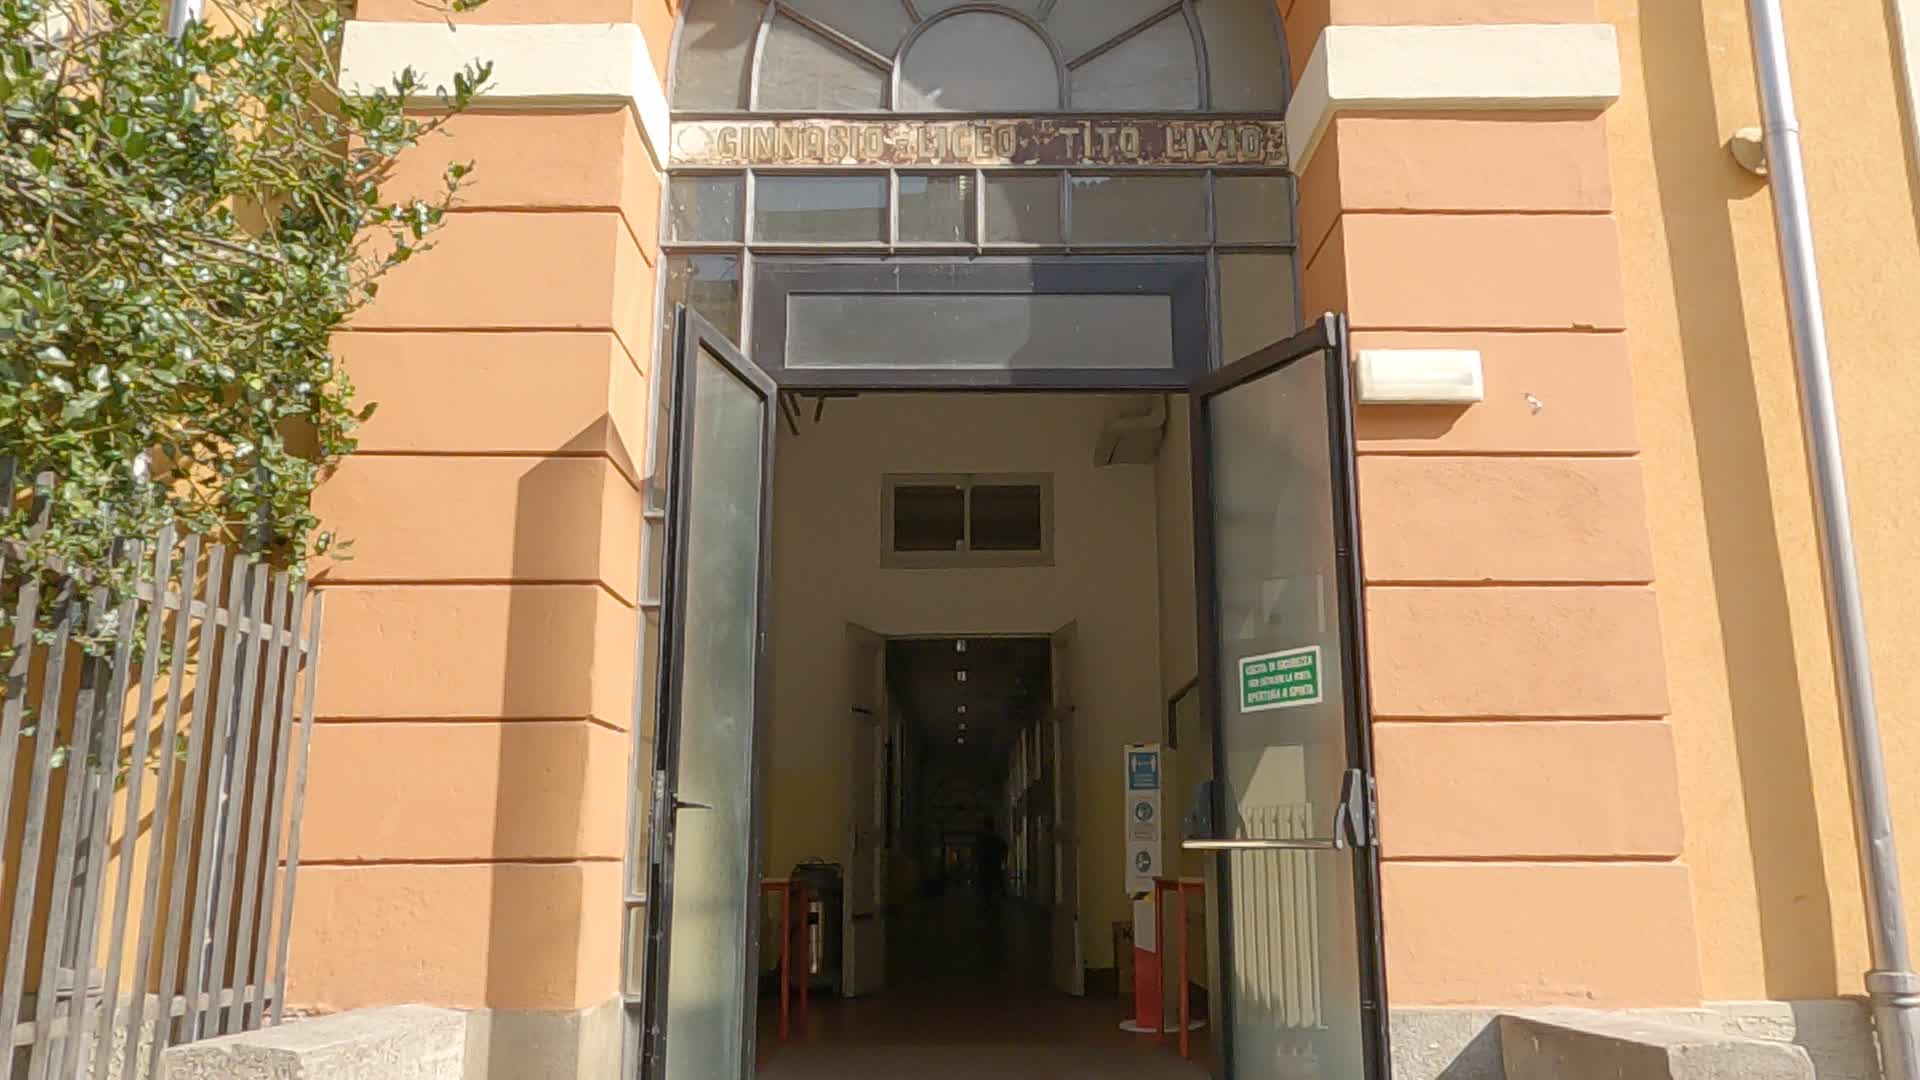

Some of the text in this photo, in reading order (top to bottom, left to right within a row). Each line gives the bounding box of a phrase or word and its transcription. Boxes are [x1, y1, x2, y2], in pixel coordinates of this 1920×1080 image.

[717, 125, 884, 159] GINNASIO
[916, 125, 1018, 159] LICEO
[1058, 125, 1140, 159] TITO
[1166, 124, 1265, 159] LIVIO
